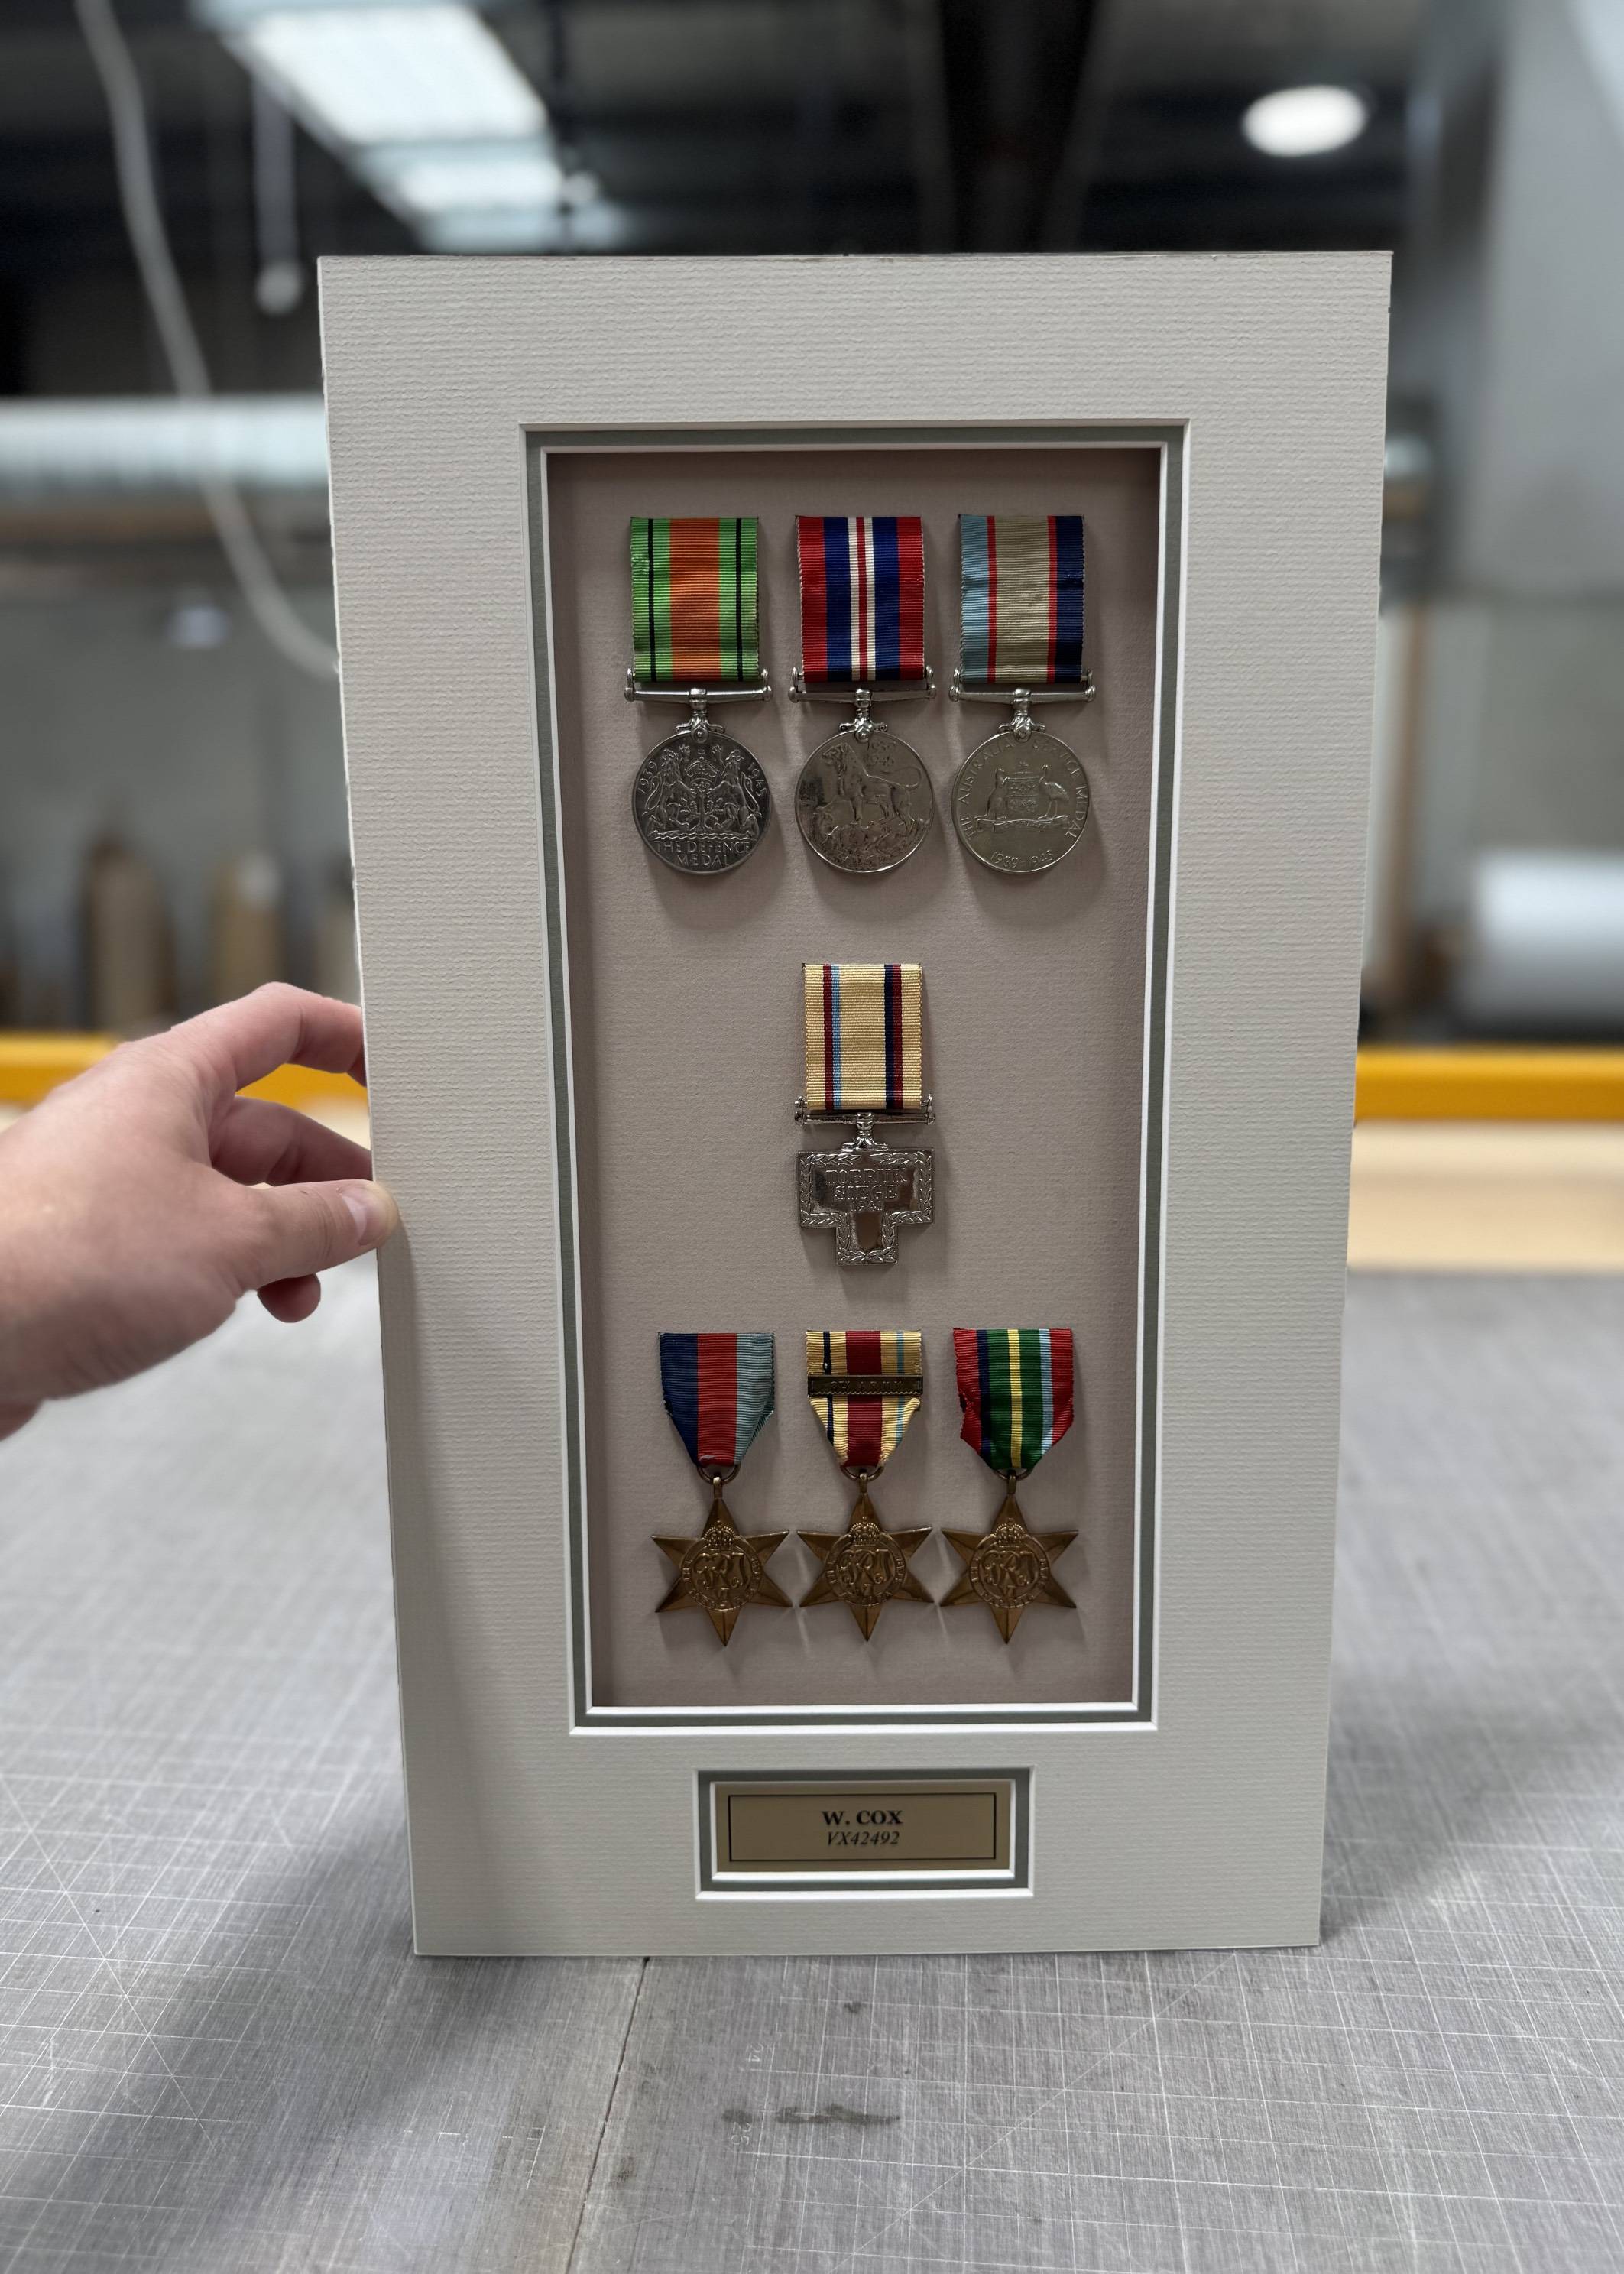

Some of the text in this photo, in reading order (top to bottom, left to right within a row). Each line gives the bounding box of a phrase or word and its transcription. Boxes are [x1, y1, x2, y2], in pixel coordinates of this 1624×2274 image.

[653, 841, 752, 853] THE DEFENCE
[676, 854, 730, 866] MEDAL
[825, 1167, 908, 1186] TOBRUK
[834, 1185, 899, 1200] SIEGE
[822, 1809, 903, 1825] W. COX
[828, 1831, 900, 1846] VX42492
